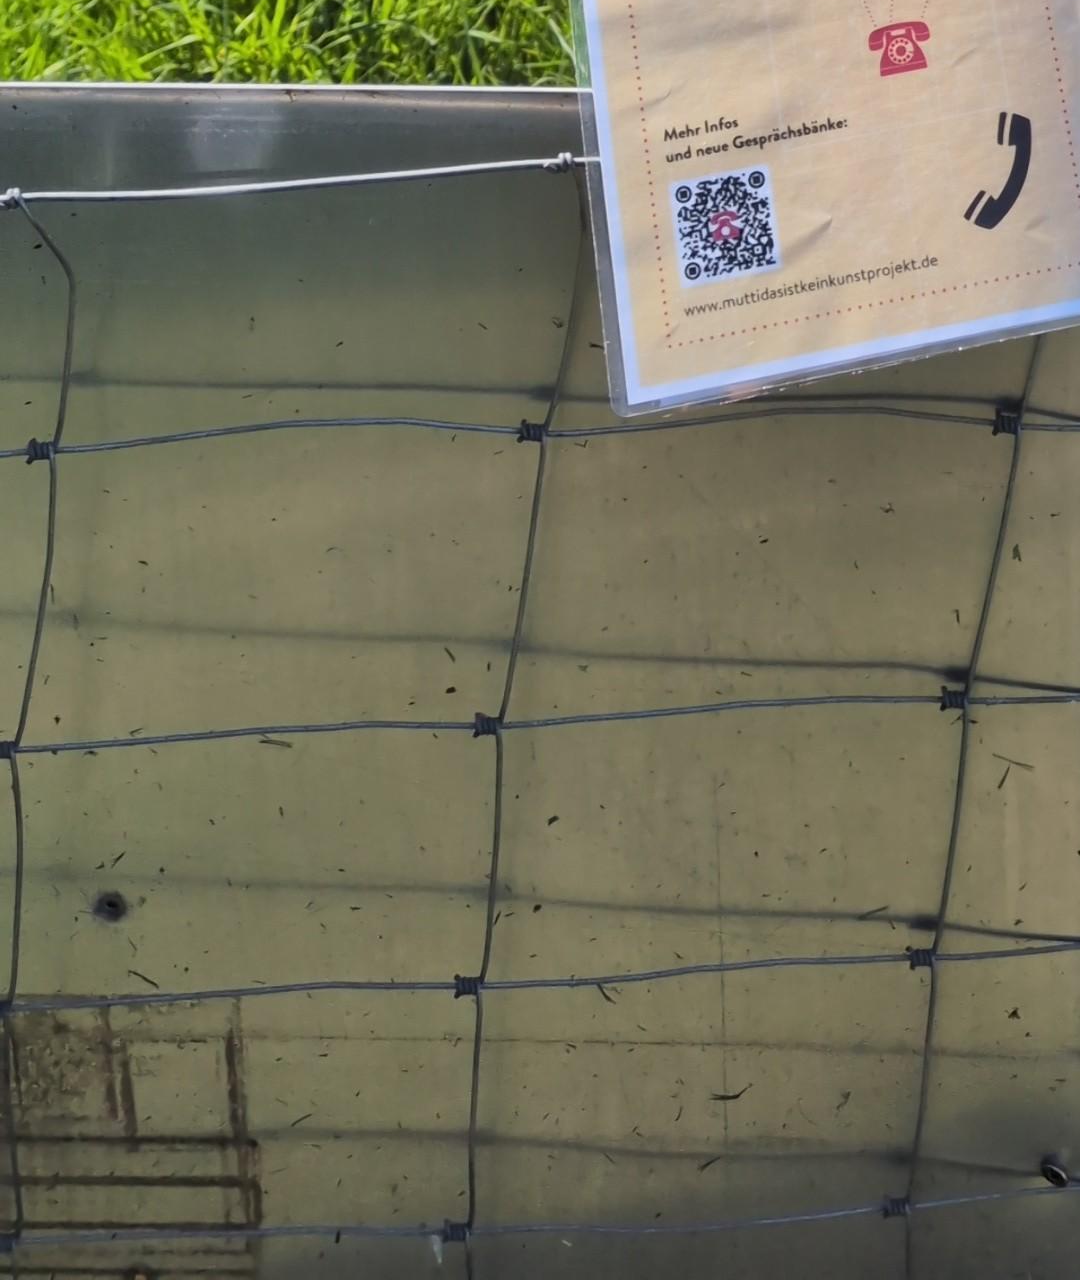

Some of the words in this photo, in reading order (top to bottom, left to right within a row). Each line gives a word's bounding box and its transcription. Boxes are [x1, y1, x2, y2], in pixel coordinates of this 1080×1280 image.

[663, 124, 702, 142] Mehr
[704, 116, 739, 134] Infos
[665, 145, 693, 163] und
[696, 143, 730, 158] neue
[732, 117, 849, 150] Gesprächsbänke:
[683, 254, 939, 318] www.muttidasistkeinkunstprojekt.de
